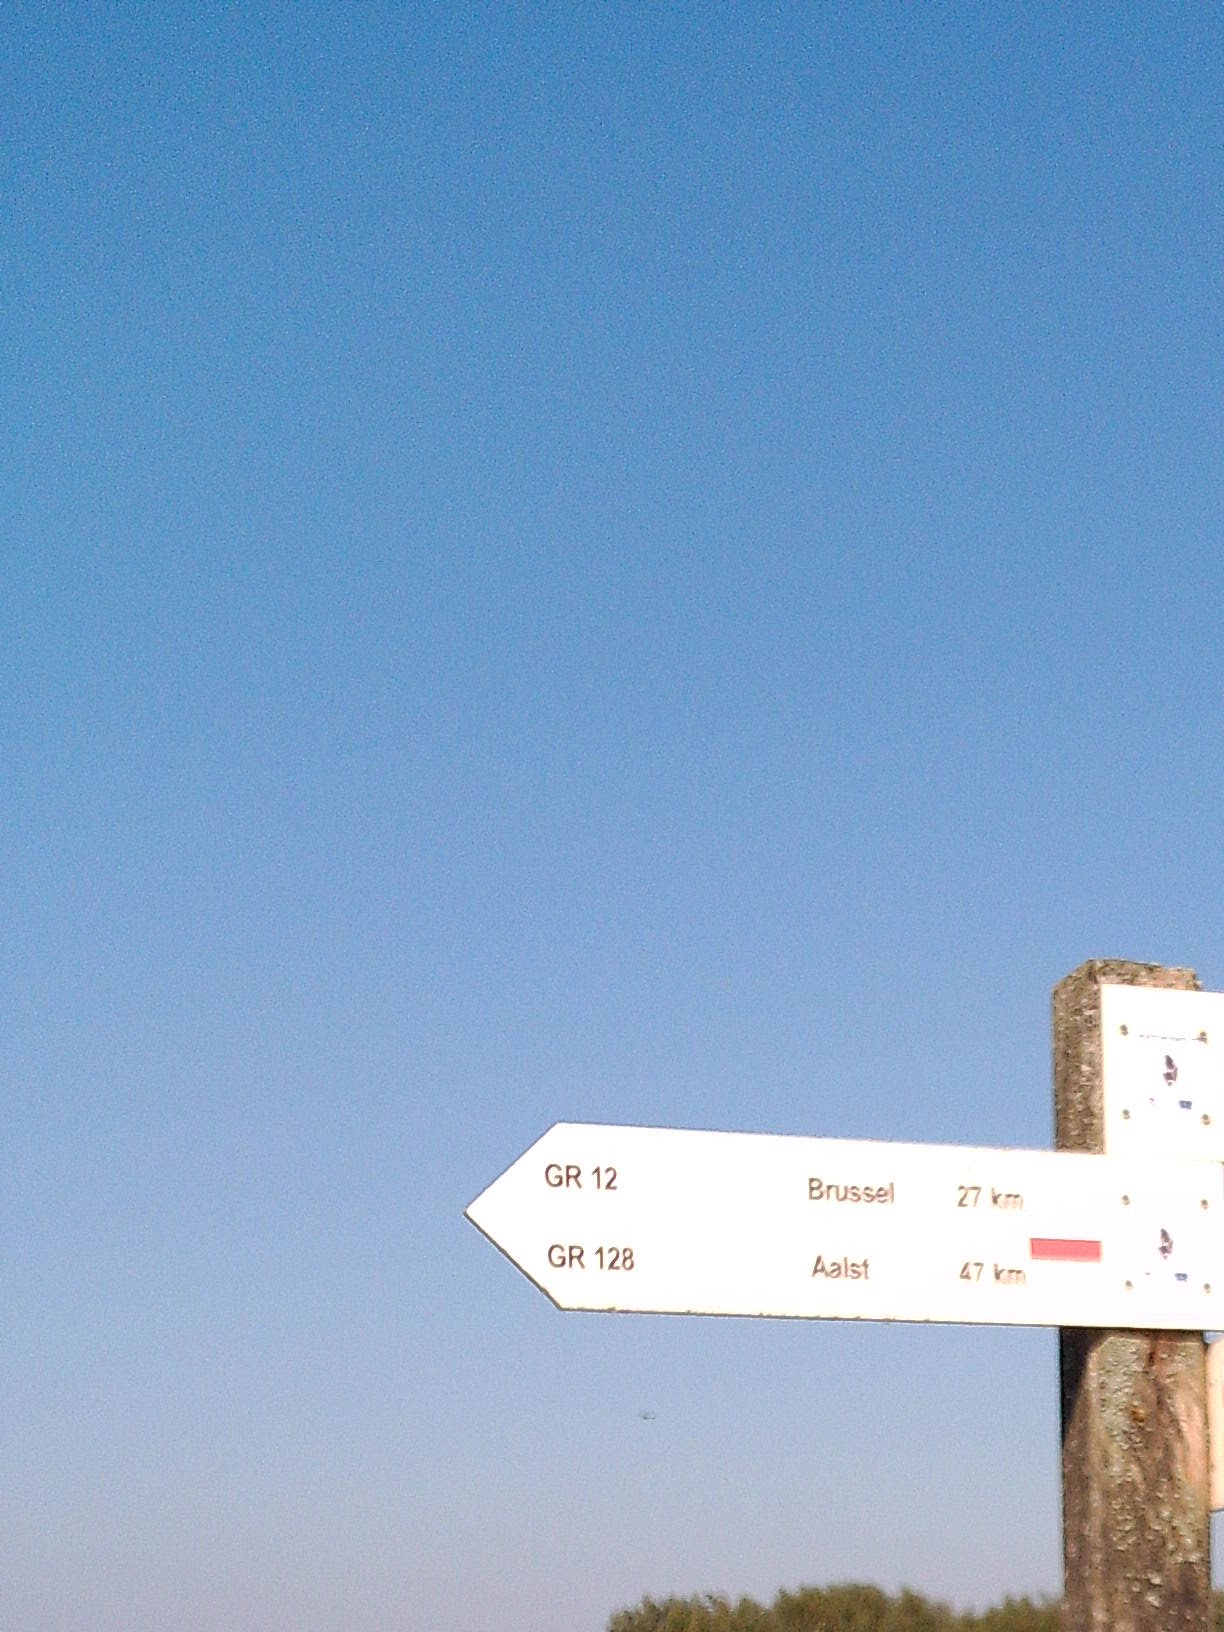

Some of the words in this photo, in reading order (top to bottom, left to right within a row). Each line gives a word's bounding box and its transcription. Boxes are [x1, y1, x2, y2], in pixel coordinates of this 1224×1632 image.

[544, 1163, 582, 1190] GR
[591, 1166, 618, 1191] 12
[808, 1177, 895, 1205] Brussel
[957, 1186, 981, 1208] 27
[991, 1187, 1024, 1210] km
[547, 1244, 585, 1270] GR
[594, 1246, 635, 1272] 128
[812, 1255, 870, 1281] Aalst
[959, 1261, 984, 1282] 47
[994, 1263, 1026, 1286] km
